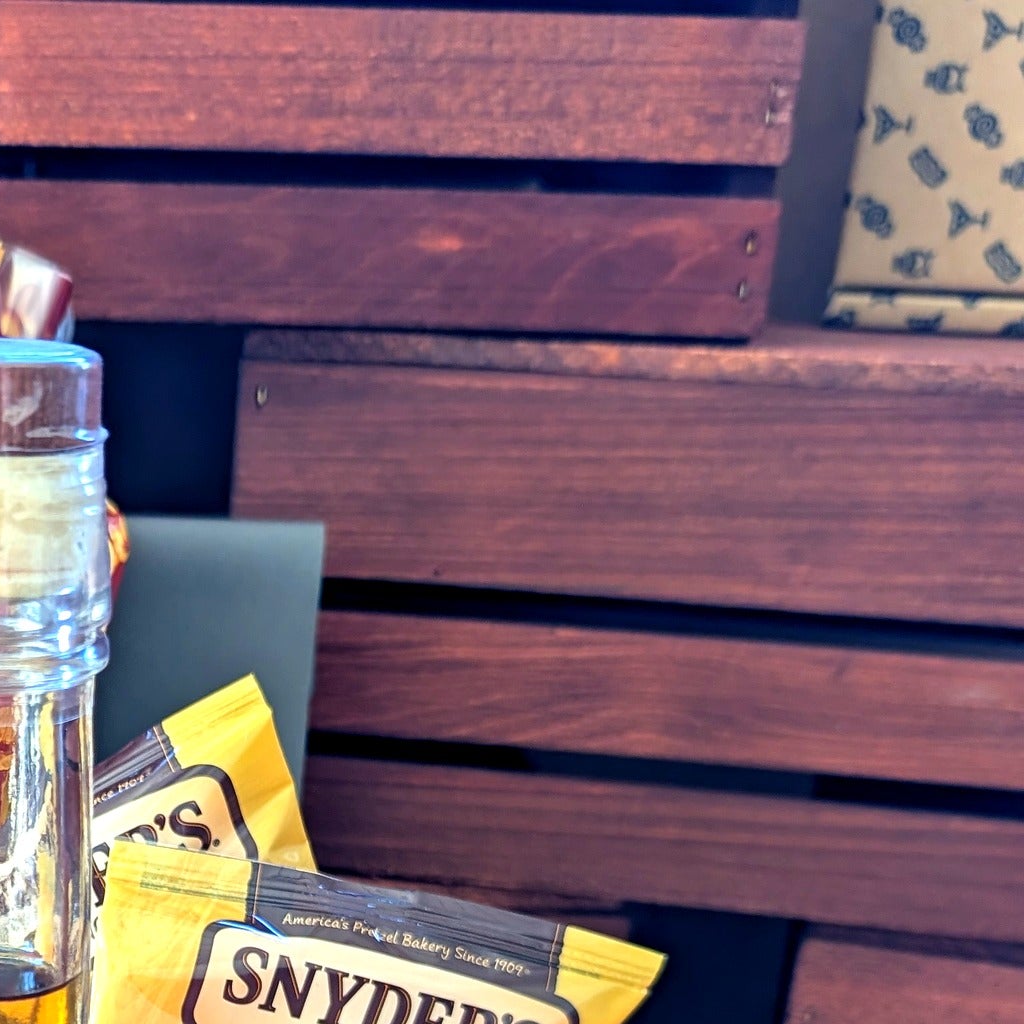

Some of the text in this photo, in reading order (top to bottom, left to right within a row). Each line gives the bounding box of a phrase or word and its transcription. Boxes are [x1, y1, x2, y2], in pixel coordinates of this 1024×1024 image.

[282, 912, 350, 931] America's
[352, 920, 398, 945] Pretzel
[402, 934, 451, 961] Bakery
[454, 946, 490, 968] Since
